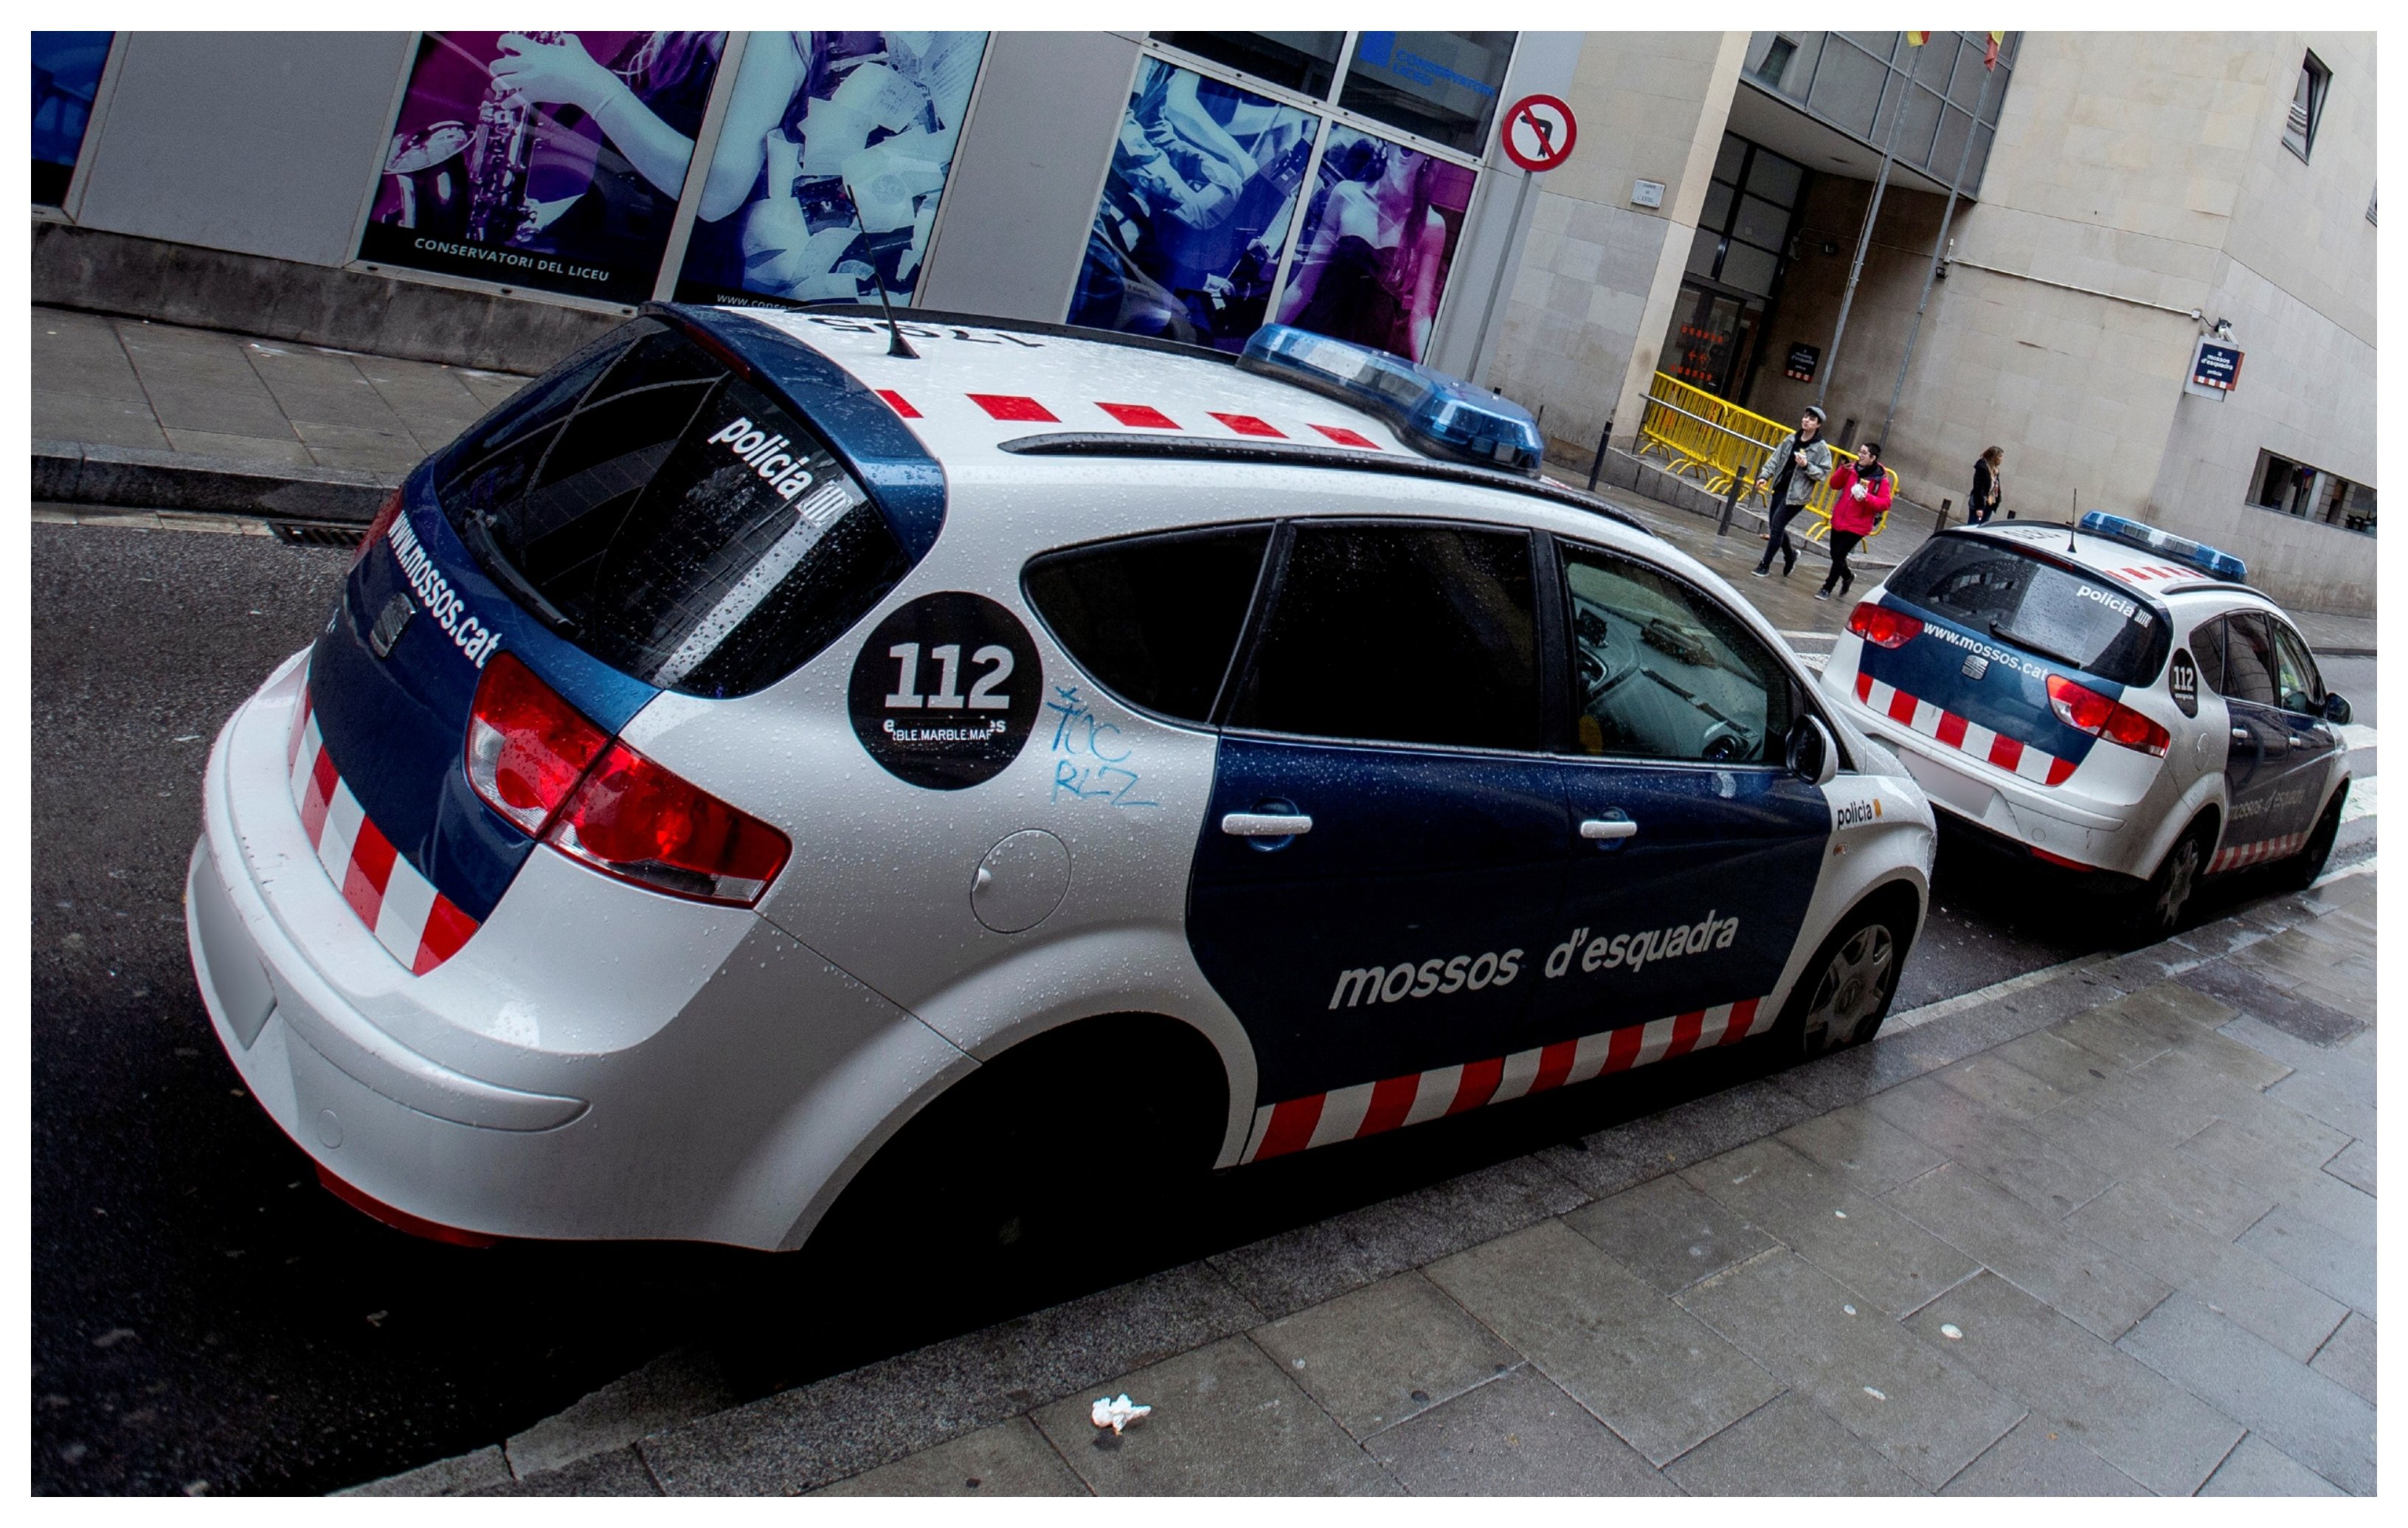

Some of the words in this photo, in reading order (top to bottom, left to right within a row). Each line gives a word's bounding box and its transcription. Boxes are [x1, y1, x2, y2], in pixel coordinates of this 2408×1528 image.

[414, 238, 534, 269] CONSERVATORI
[537, 260, 564, 274] DEL
[568, 266, 610, 282] LICEU
[707, 416, 814, 500] policia
[387, 509, 503, 669] www.mossos.cat
[2076, 584, 2135, 618] policia
[885, 642, 1015, 709] 112
[1923, 622, 2049, 682] www.mossos.cat
[2173, 666, 2194, 691] 112
[1837, 799, 1873, 832] policia
[1328, 948, 1525, 1010] mossos
[1543, 909, 1740, 978] d'esquadra
